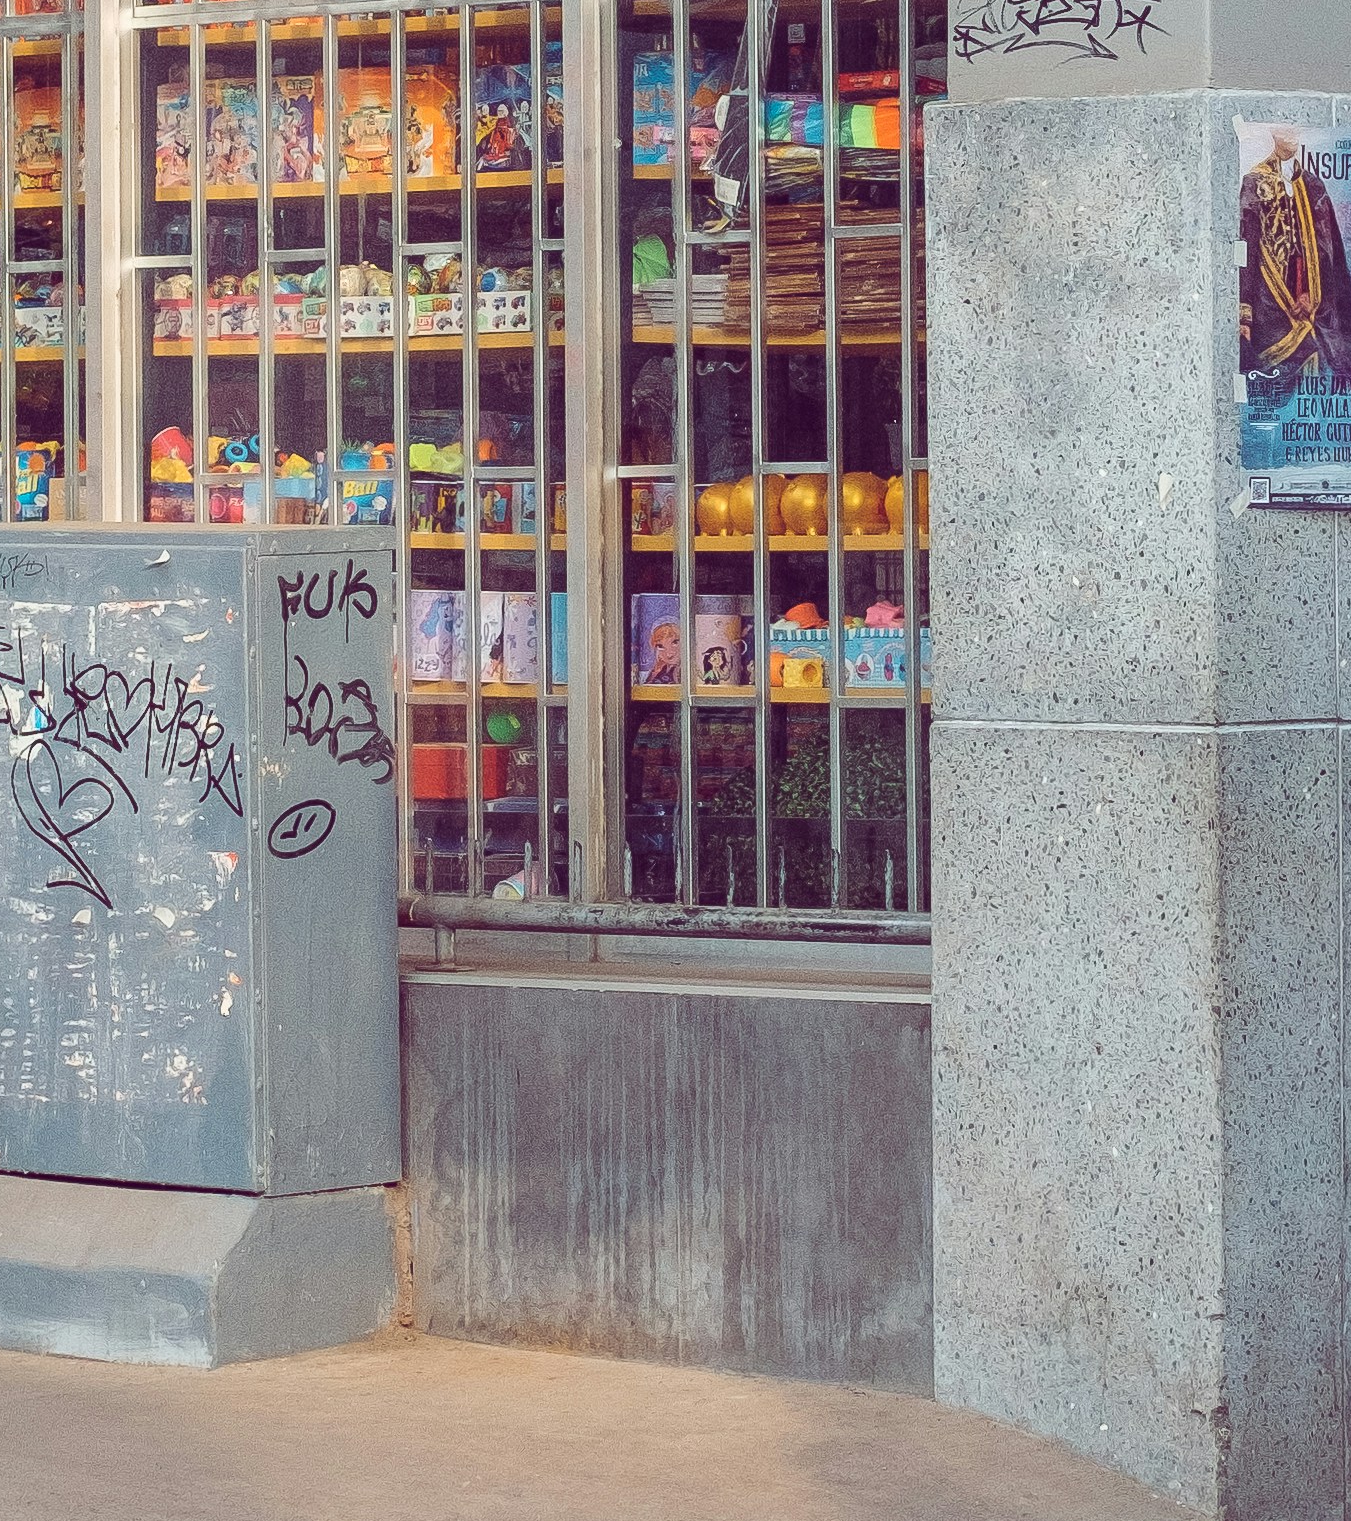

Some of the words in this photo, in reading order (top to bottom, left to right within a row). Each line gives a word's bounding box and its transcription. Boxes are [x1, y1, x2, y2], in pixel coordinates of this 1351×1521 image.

[1297, 375, 1328, 396] LUIS
[1297, 398, 1320, 418] LEO
[1281, 417, 1322, 443] HÉCTOR
[1295, 446, 1331, 463] REYES
